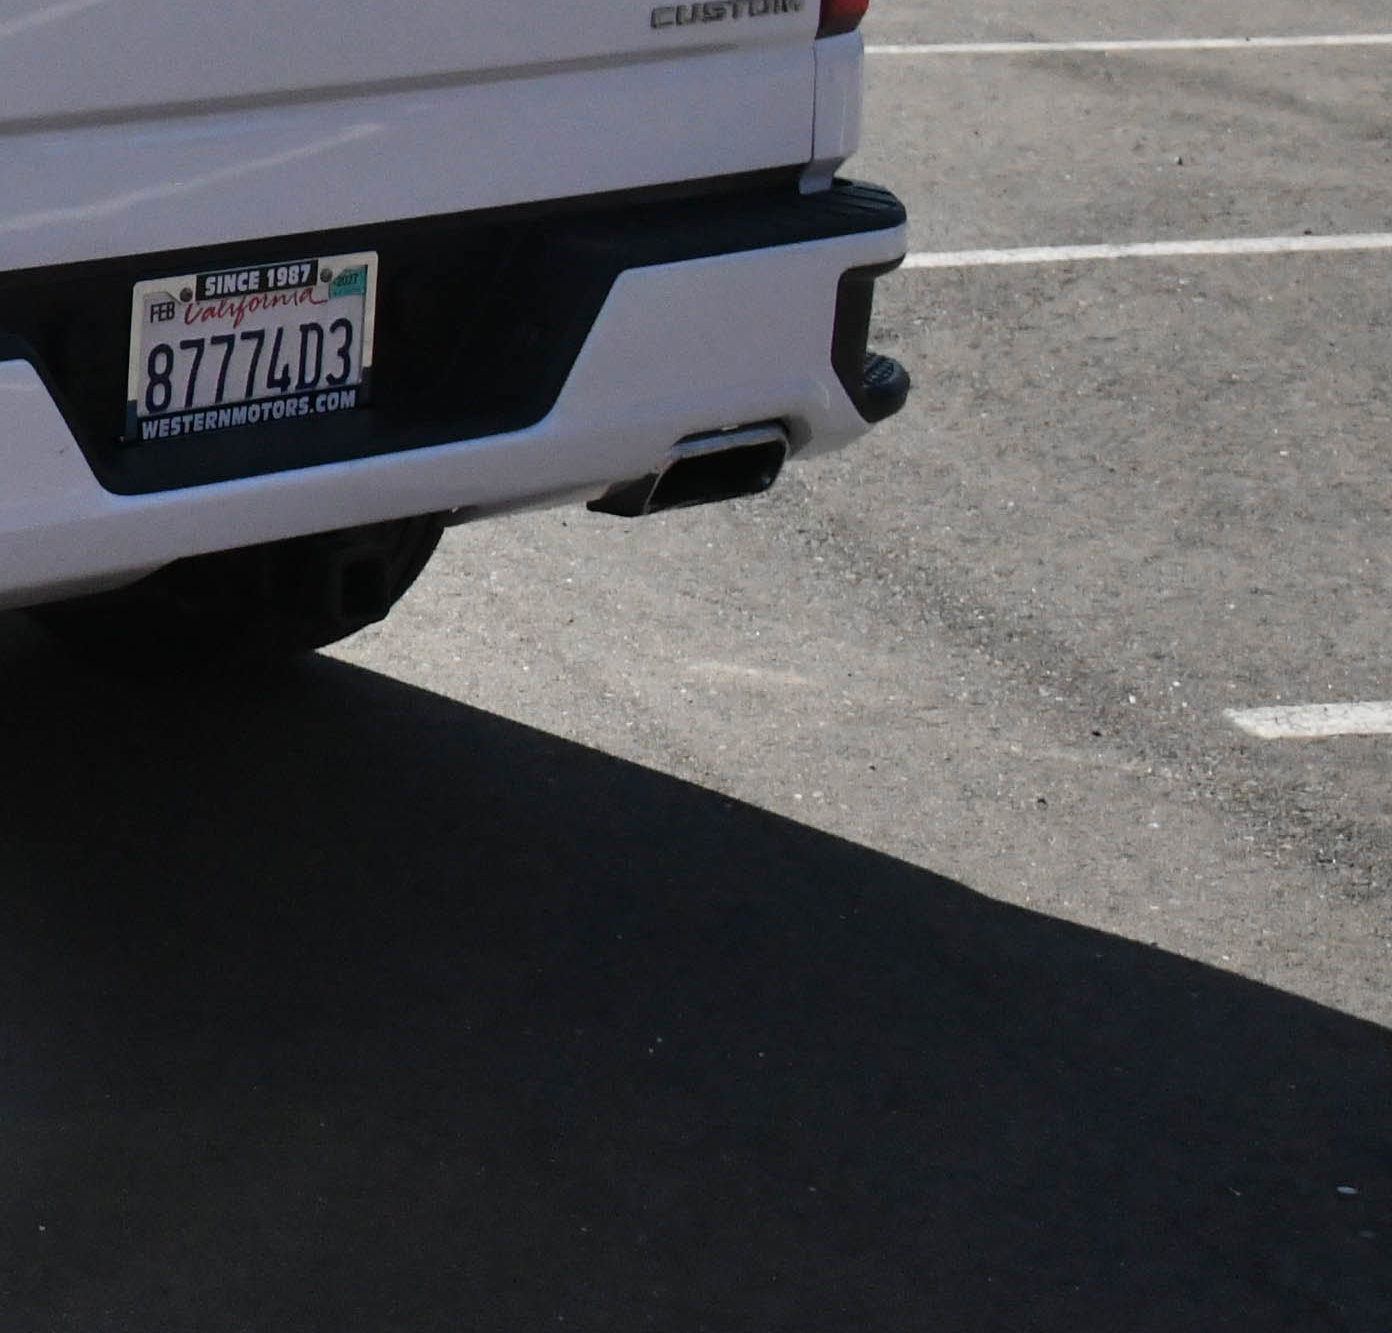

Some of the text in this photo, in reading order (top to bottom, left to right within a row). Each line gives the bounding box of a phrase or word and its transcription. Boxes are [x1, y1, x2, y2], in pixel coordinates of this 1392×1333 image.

[204, 264, 312, 297] SINCE 1987
[149, 301, 176, 324] FEB
[183, 285, 327, 329] California
[144, 317, 354, 415] 87774D3
[141, 389, 358, 441] WESTERNMOTORS.COM
